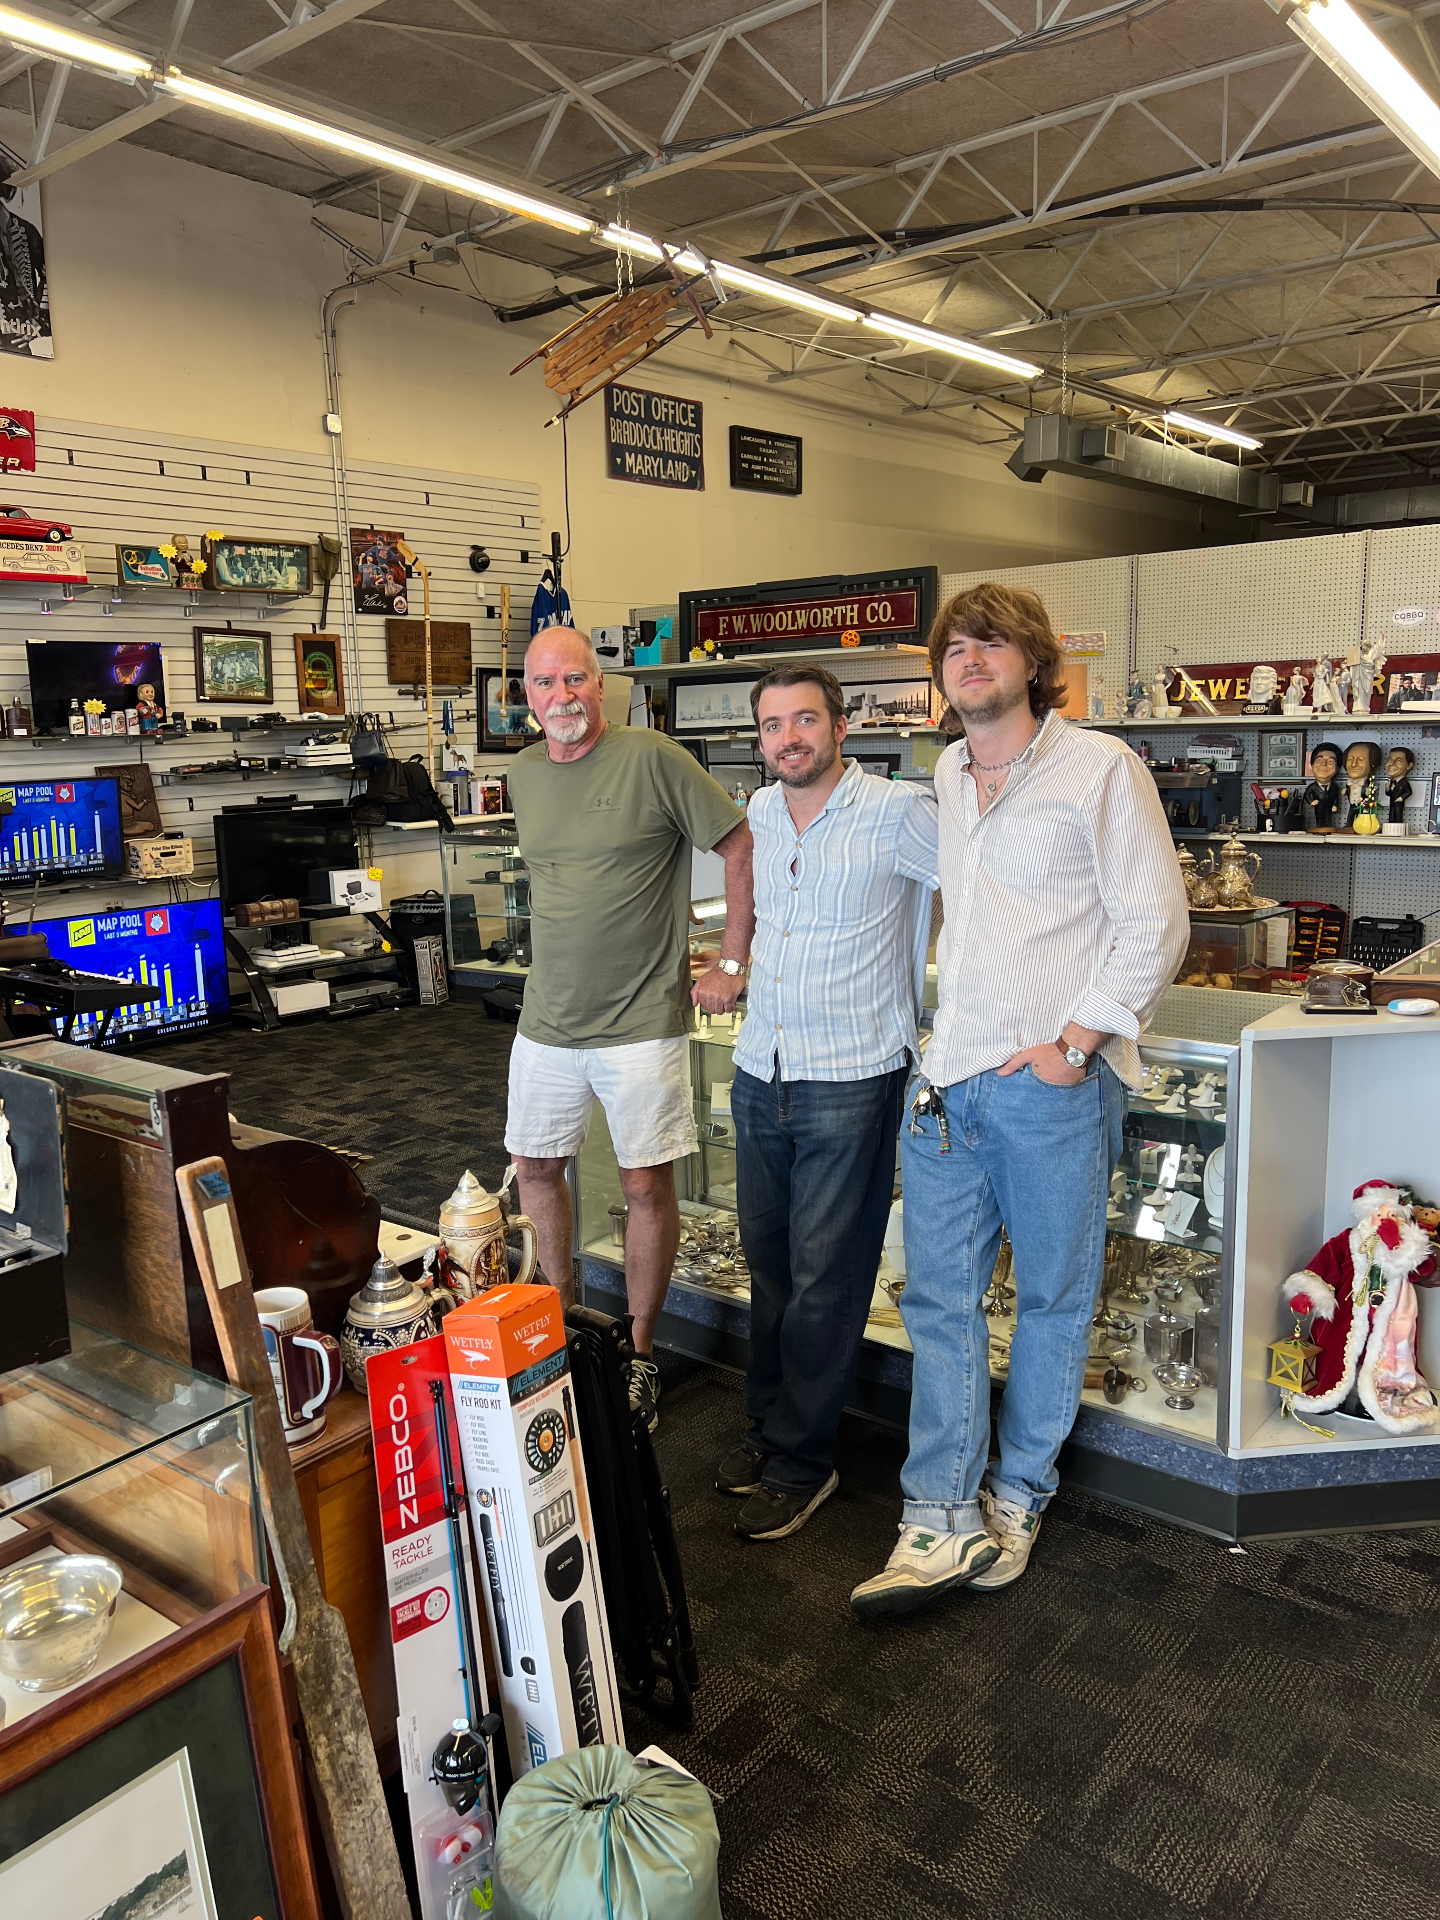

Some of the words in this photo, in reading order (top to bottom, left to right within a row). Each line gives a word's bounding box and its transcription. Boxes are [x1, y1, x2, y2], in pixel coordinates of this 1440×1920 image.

[0, 318, 42, 338] ndrix
[613, 387, 645, 419] POST
[651, 396, 697, 427] OFFICE
[741, 435, 767, 445] LANCASHIRE
[774, 441, 796, 450] YORKSHIRE
[741, 453, 762, 462] CARRIAGE
[759, 447, 778, 455] RAILWAY
[625, 451, 689, 483] MARYLAND
[751, 464, 777, 473] ADMITTANCE
[764, 475, 785, 483] BUSINESS
[0, 541, 24, 551] CEDES
[25, 543, 44, 552] BENZ
[261, 547, 279, 557] Miller
[718, 616, 729, 636] F.
[732, 614, 748, 634] W.
[750, 603, 860, 634] WOOLWORTH
[866, 601, 896, 624] CO.
[18, 787, 34, 798] MAP
[36, 786, 53, 796] POOL
[97, 917, 118, 932] MAP
[120, 914, 142, 929] POOL
[104, 932, 115, 940] LAST
[120, 929, 139, 938] MONTHS
[122, 1016, 127, 1025] 9
[132, 1015, 139, 1023] 10
[155, 1010, 161, 1018] 15
[513, 1313, 552, 1342] WETFLY
[450, 1335, 494, 1350] WETFLY
[520, 1355, 562, 1387] ELEMENT
[464, 1382, 498, 1392] ELEMENT
[460, 1396, 472, 1407] FLY
[474, 1398, 489, 1409] ROD
[490, 1399, 501, 1411] KIT
[389, 1393, 419, 1530] ZEBCO
[391, 1533, 432, 1560] READY
[393, 1545, 434, 1570] TACKLE
[394, 1566, 429, 1586] MATERIALES
[395, 1583, 403, 1592] DE
[403, 1575, 423, 1588] PESCA
[575, 1653, 604, 1749] WETF
